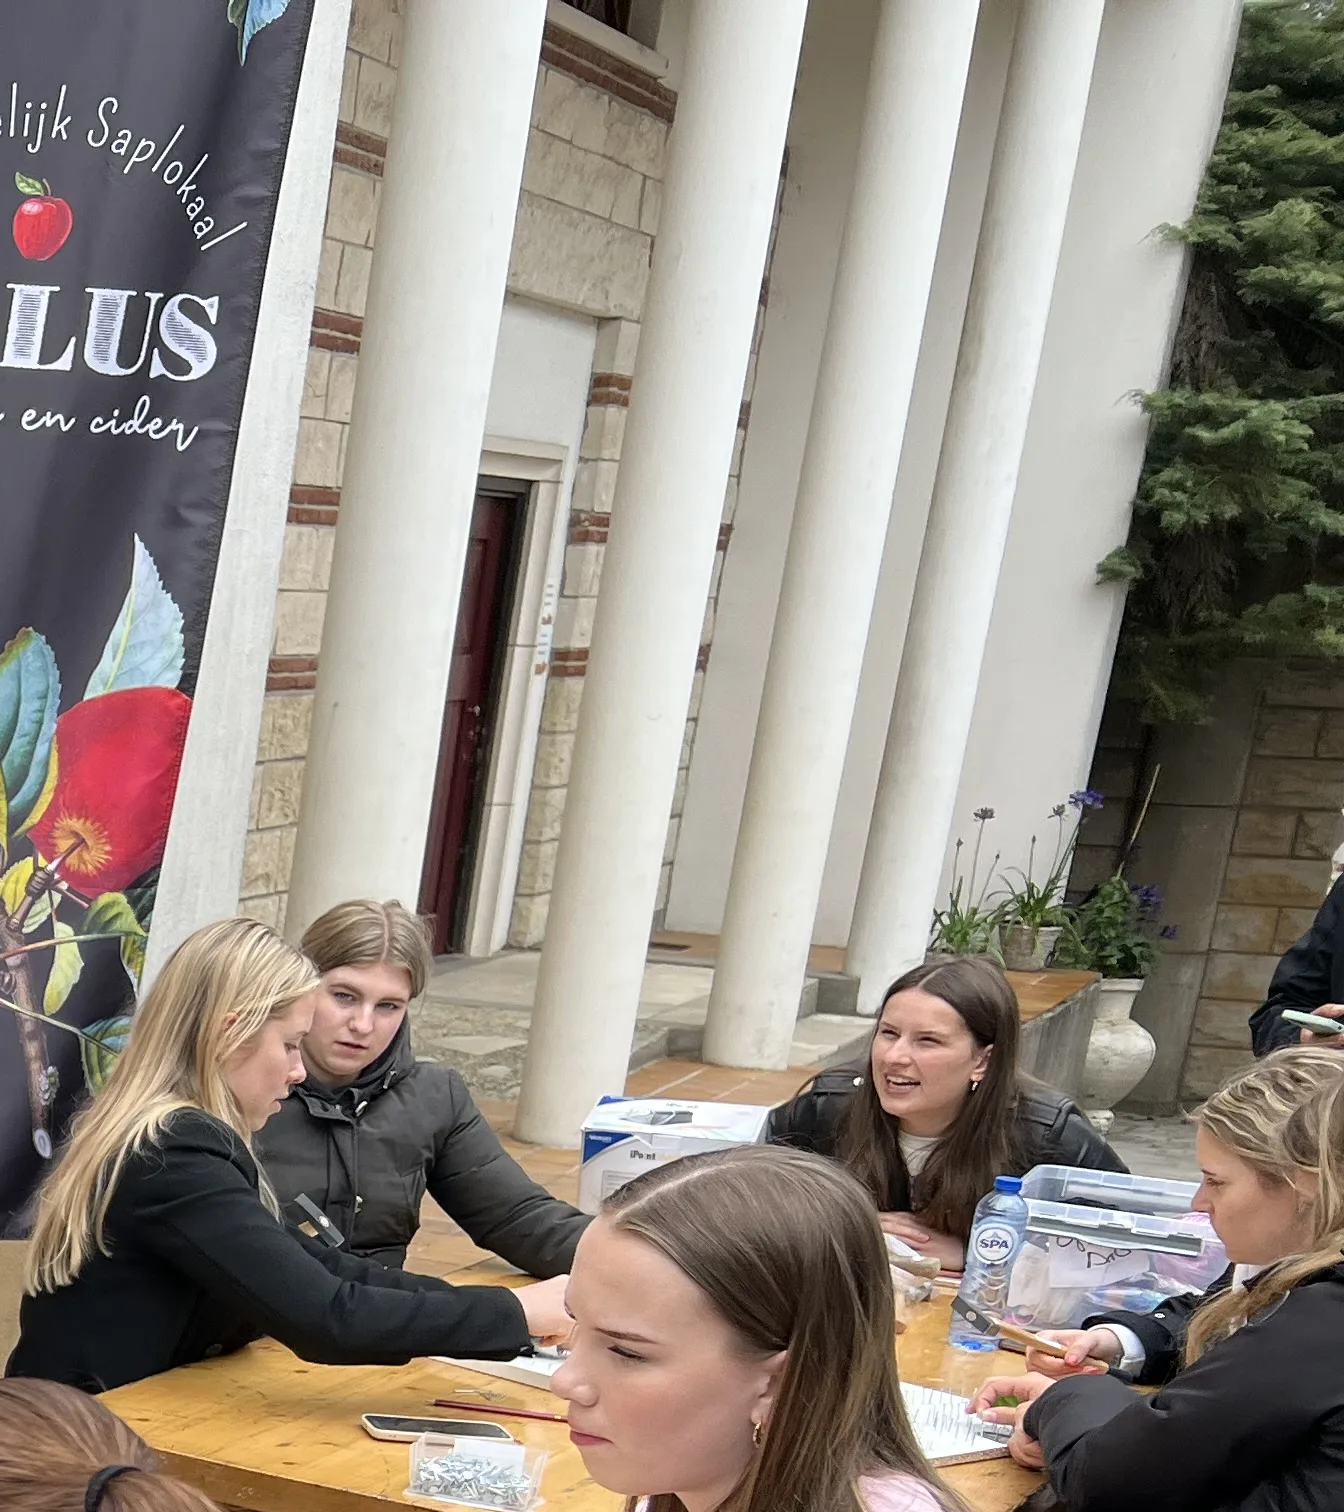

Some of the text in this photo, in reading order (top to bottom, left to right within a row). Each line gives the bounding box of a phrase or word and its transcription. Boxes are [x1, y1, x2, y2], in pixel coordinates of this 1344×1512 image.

[87, 97, 248, 251] Saplokaal
[21, 407, 75, 433] en
[89, 395, 199, 451] cider
[979, 1238, 1009, 1249] SPA
